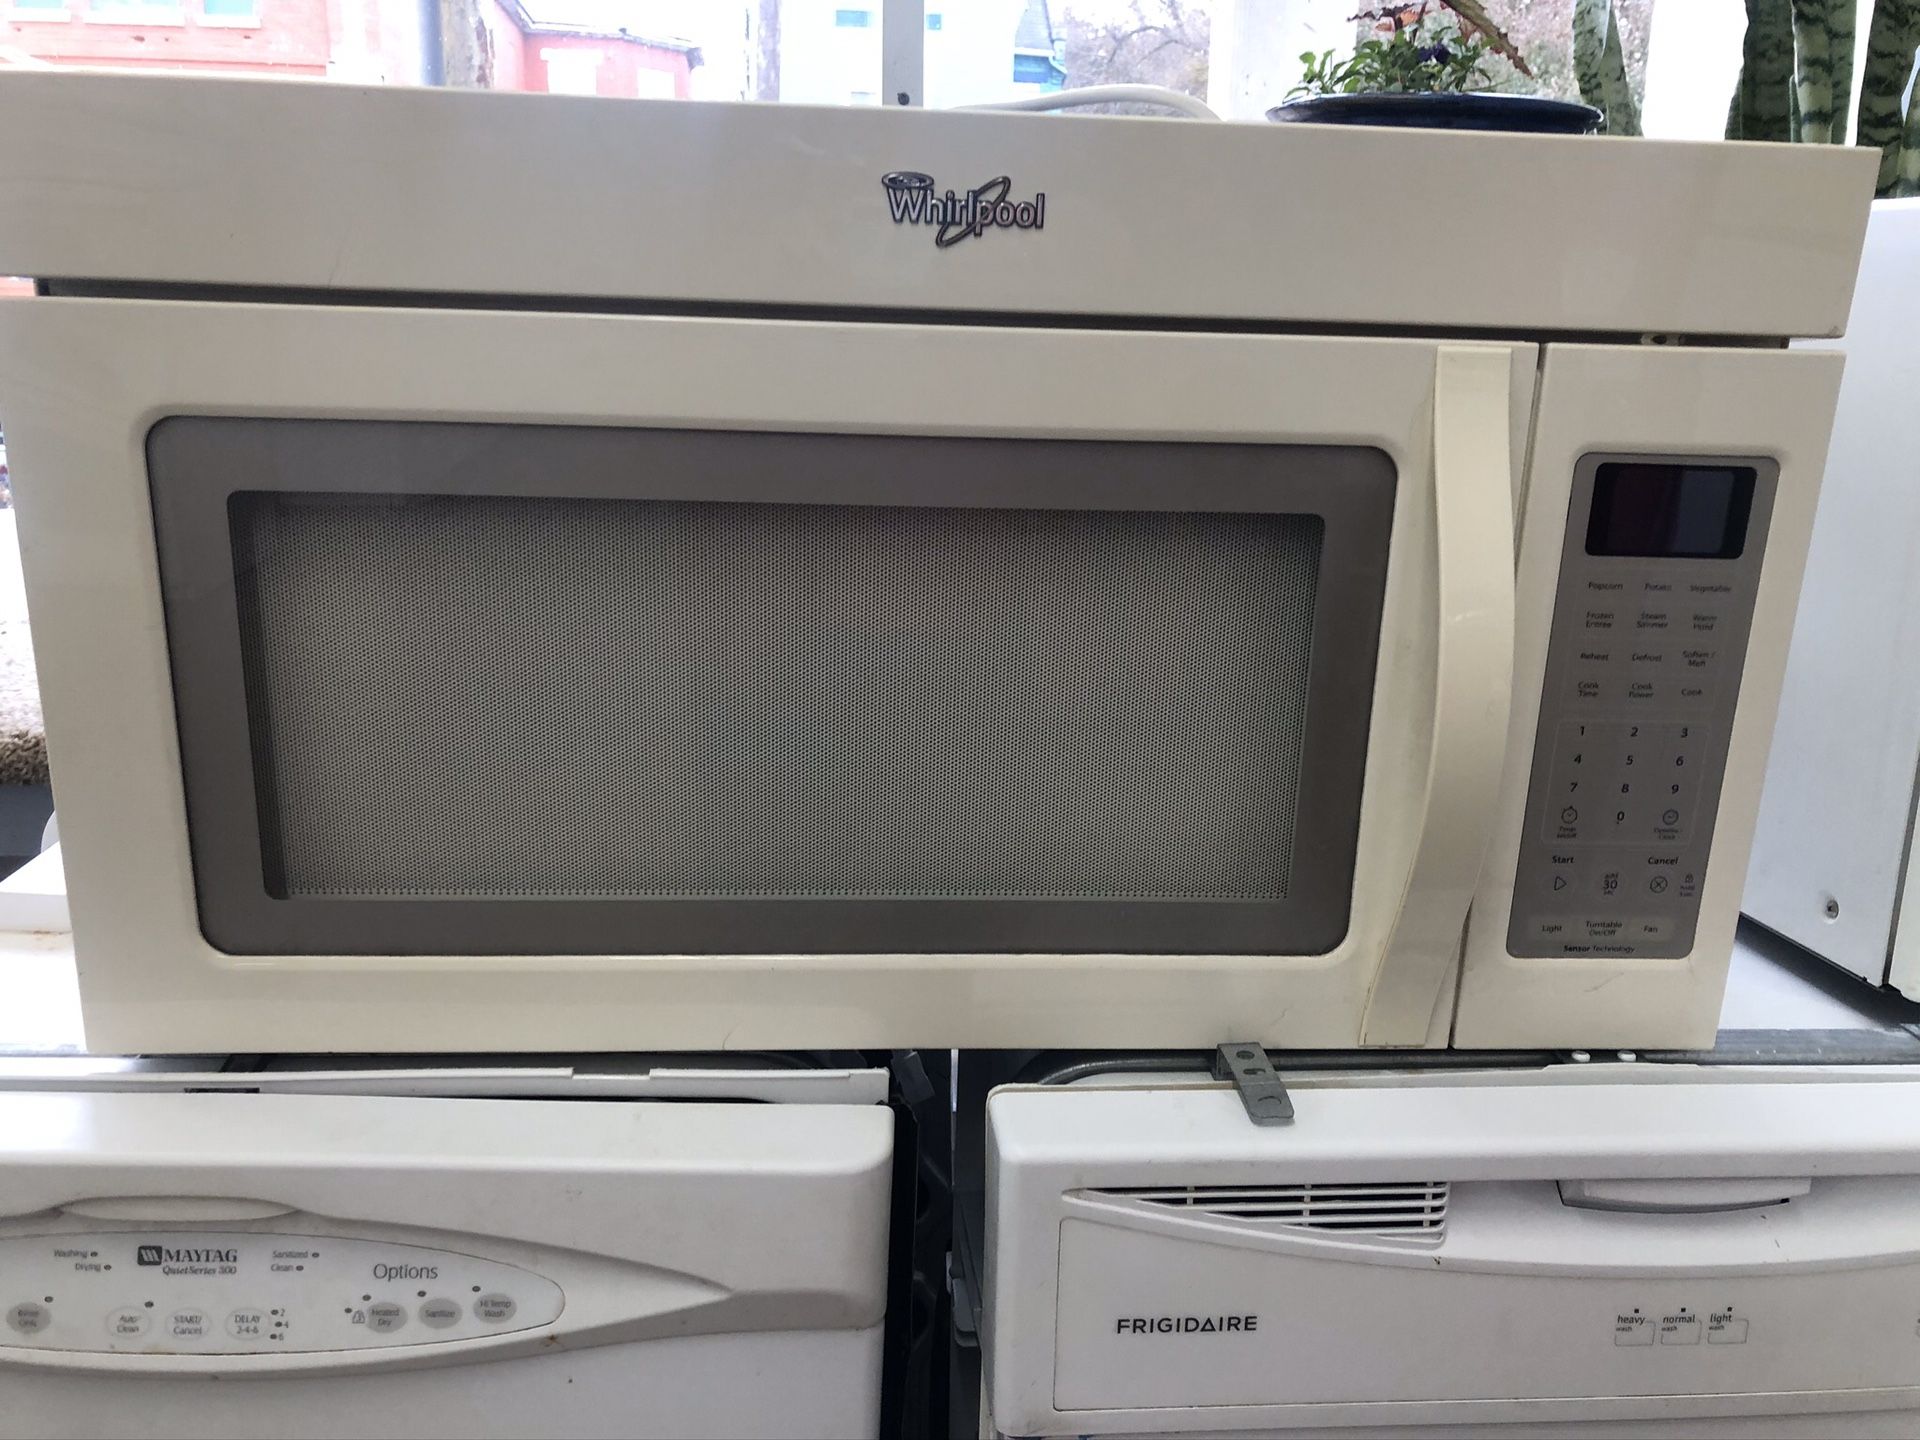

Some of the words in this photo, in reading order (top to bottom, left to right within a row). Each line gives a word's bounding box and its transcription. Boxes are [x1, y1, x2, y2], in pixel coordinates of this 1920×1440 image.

[882, 171, 1045, 248] Whirlpool
[1588, 582, 1623, 591] Popcorn
[1631, 653, 1662, 662] Defrost
[1578, 681, 1599, 689] Cook
[1631, 682, 1653, 690] Cook
[1579, 726, 1585, 736] 1
[1630, 727, 1638, 737] 2
[1681, 728, 1688, 737] 3
[1574, 755, 1582, 764] 4
[1626, 755, 1634, 765] 5
[1676, 756, 1683, 766] 6
[1570, 782, 1578, 792] 7
[1621, 783, 1629, 793] 8
[1671, 784, 1679, 794] 9
[1617, 811, 1625, 822] 0
[1552, 855, 1574, 864] Start
[1648, 856, 1679, 865] Cancel
[1603, 880, 1618, 890] 30
[1542, 924, 1562, 933] Light
[1643, 925, 1658, 933] Fan
[54, 1249, 88, 1258] Washing
[164, 1248, 237, 1262] MAYTAG
[75, 1263, 101, 1272] Drying
[271, 1264, 294, 1272] Clean
[373, 1263, 438, 1282] Options
[234, 1315, 260, 1323] DELAY
[1617, 1315, 1645, 1325] heavy
[1663, 1314, 1695, 1323] normal
[1710, 1314, 1732, 1325] light
[117, 1325, 139, 1333] Clean
[1117, 1315, 1258, 1334] FRIGIDAIRE
[173, 1327, 202, 1335] Cancel
